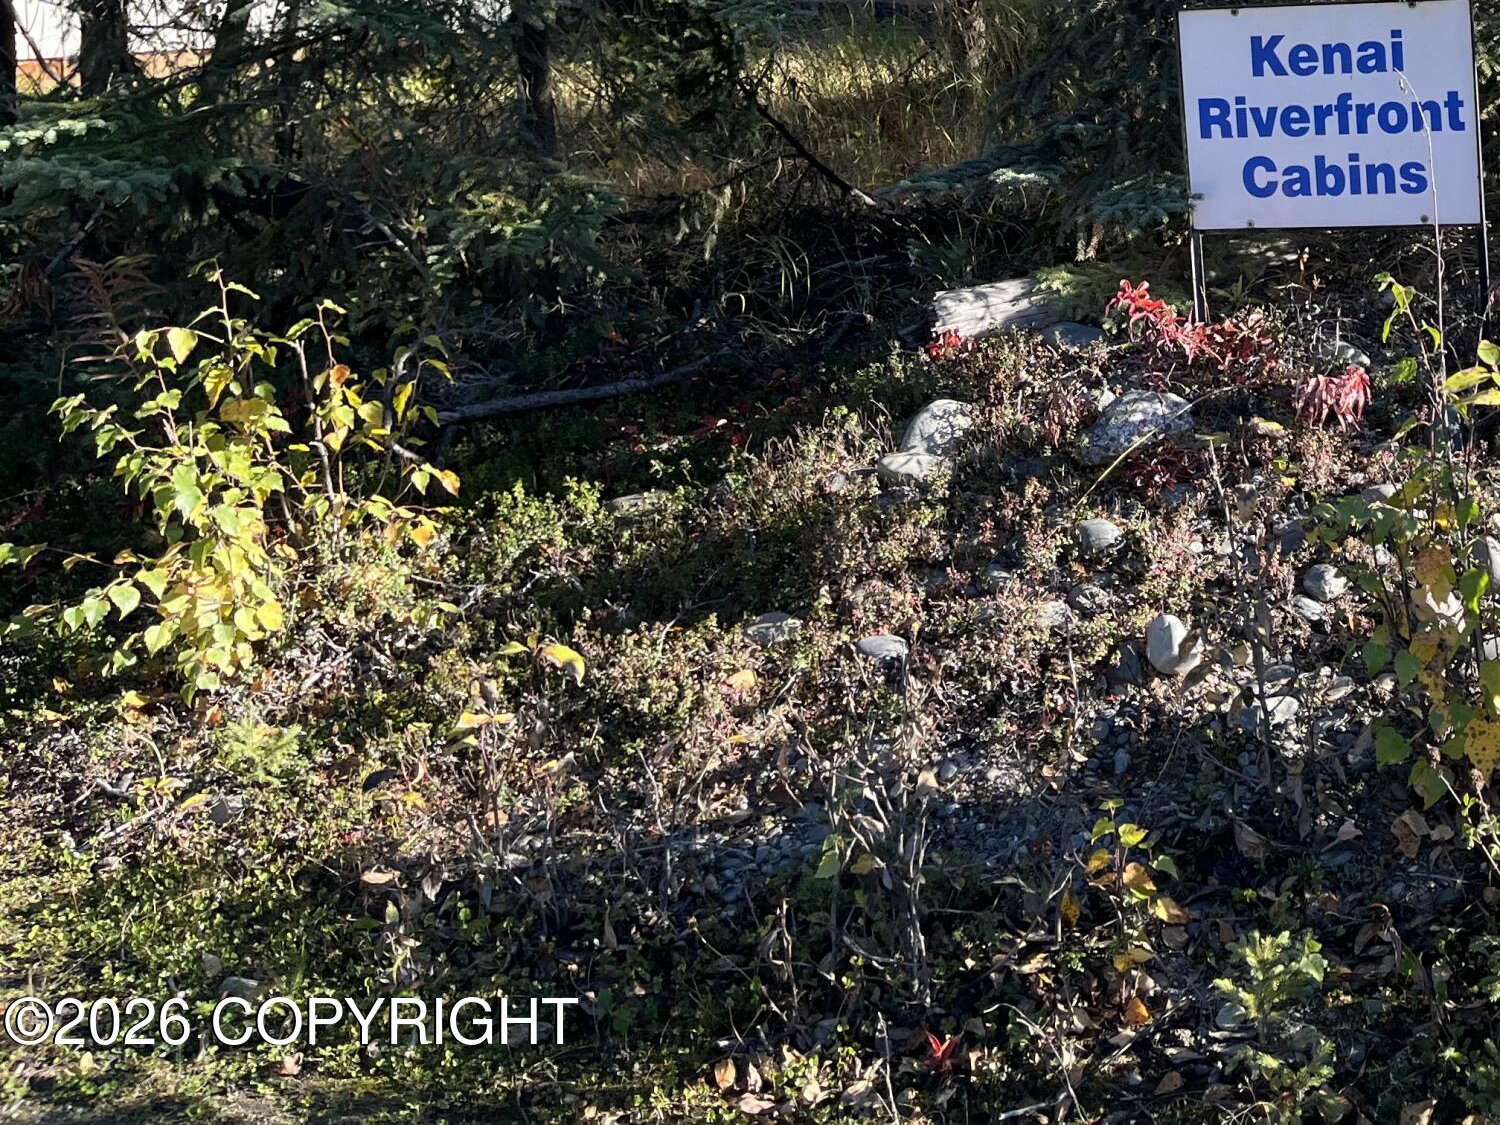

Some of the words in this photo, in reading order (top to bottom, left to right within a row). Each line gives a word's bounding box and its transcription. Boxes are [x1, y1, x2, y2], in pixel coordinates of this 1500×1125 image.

[1250, 29, 1404, 77] Kenai
[1197, 90, 1466, 139] Riverfront
[1242, 153, 1428, 199] Cabins
